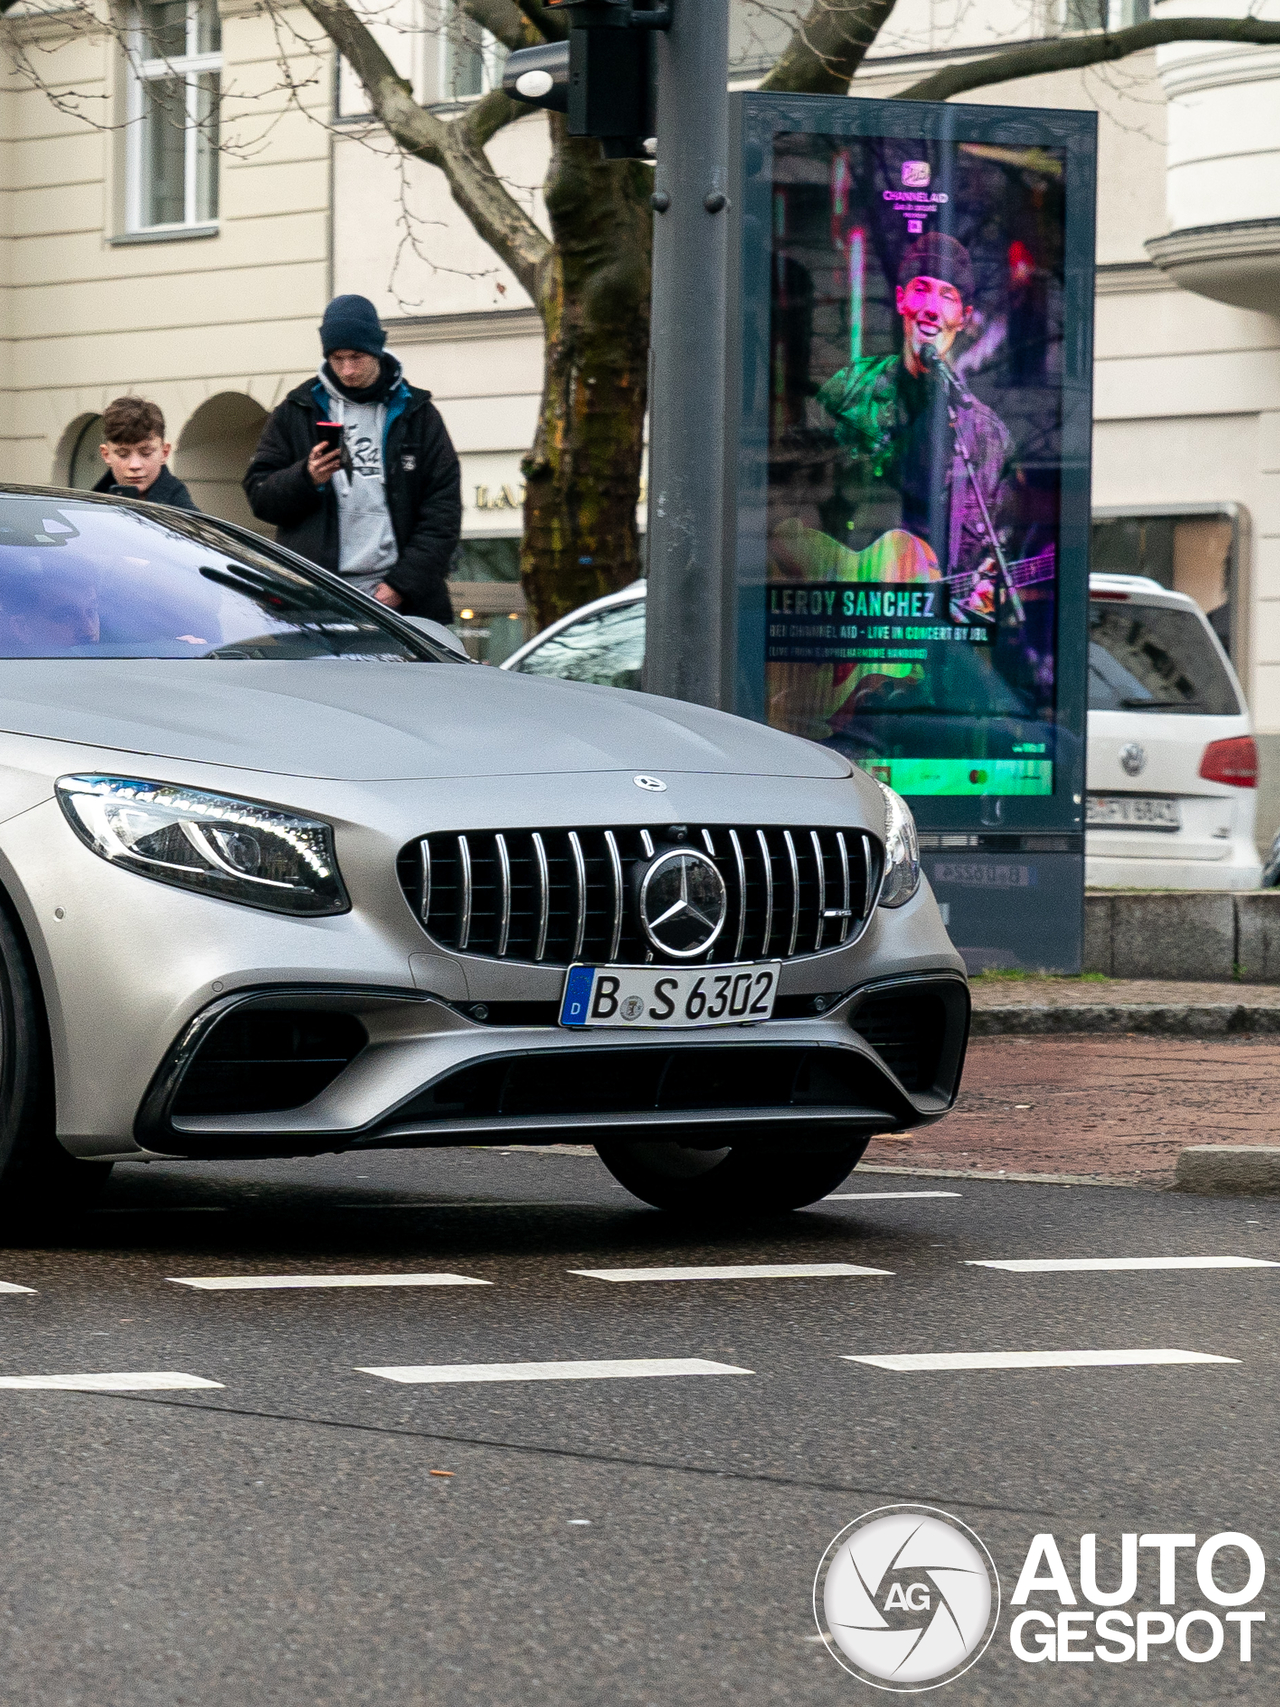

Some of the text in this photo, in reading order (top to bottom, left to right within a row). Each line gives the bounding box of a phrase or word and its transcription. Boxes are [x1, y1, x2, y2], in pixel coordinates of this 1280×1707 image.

[771, 589, 935, 617] LEROY SANCHEZ
[789, 625, 838, 638] CHANNEL
[840, 625, 858, 639] AID
[868, 626, 890, 640] LIVE
[891, 627, 903, 640] IN
[905, 627, 952, 641] CONCERT
[953, 627, 969, 641] BY
[970, 627, 989, 642] JBL
[591, 971, 774, 1020] B S 6302
[570, 1002, 581, 1015] D
